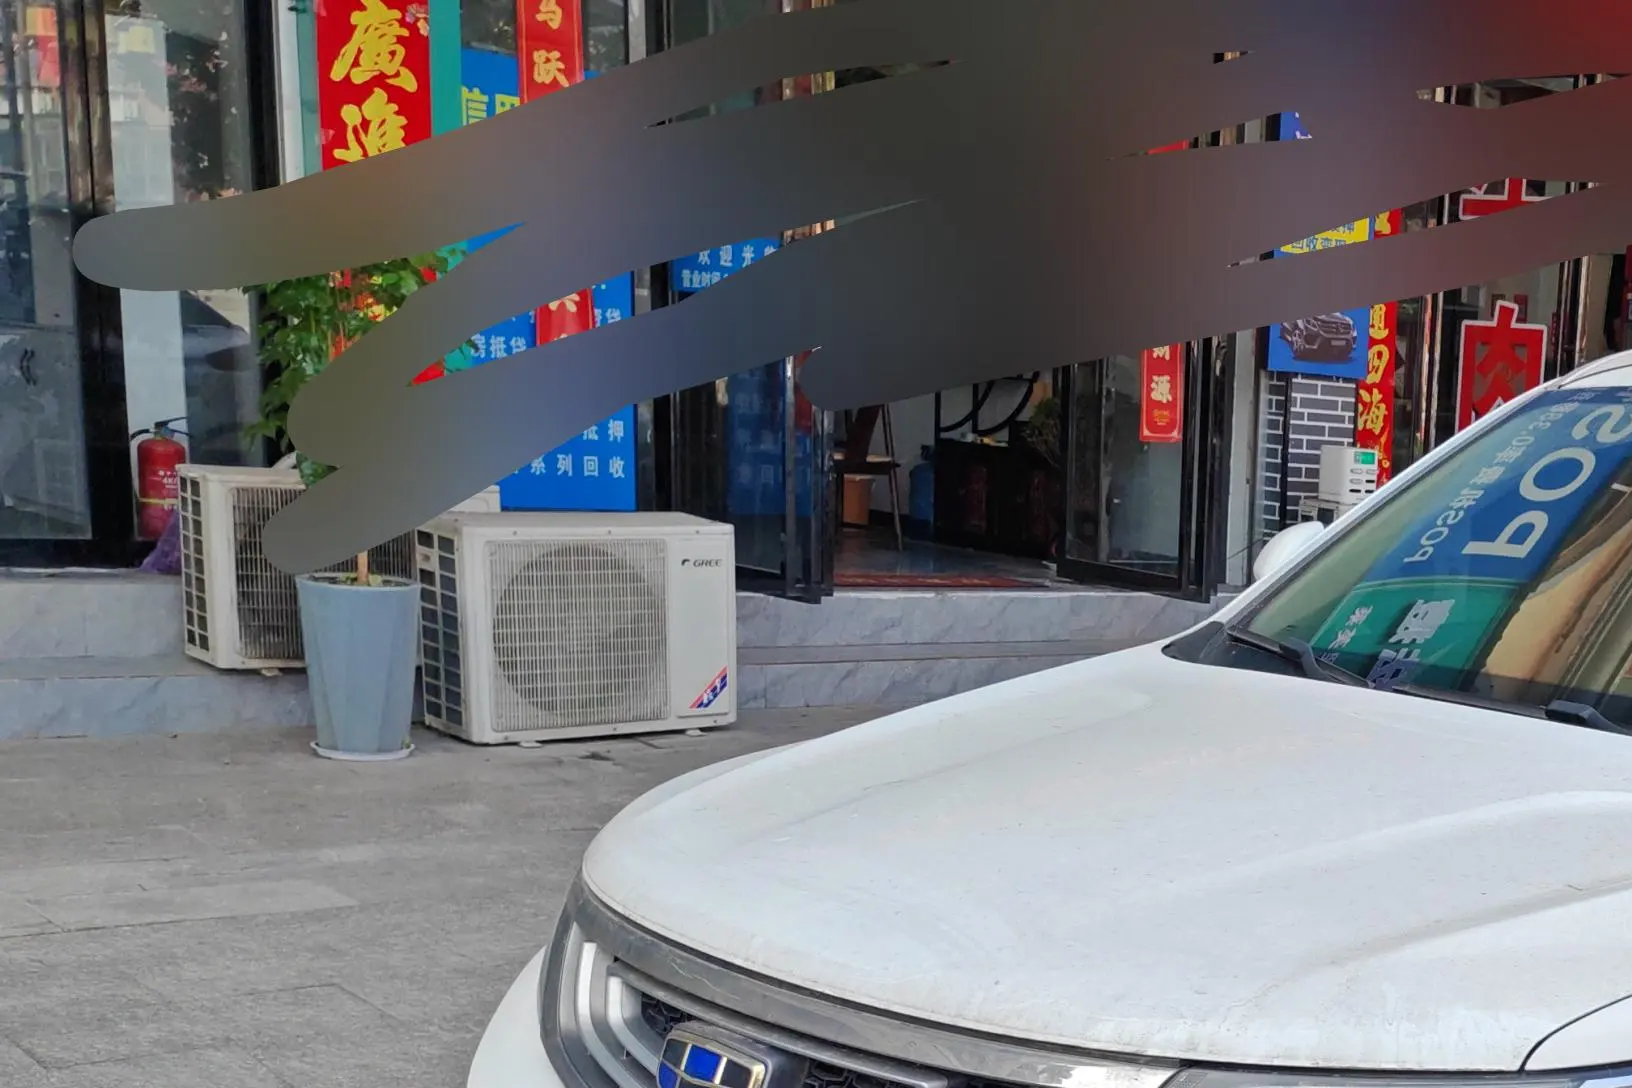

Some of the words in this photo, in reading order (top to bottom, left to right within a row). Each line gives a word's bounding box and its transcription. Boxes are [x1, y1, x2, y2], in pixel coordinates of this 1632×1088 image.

[682, 269, 729, 288] 营业时间
[692, 558, 723, 568] GREE
